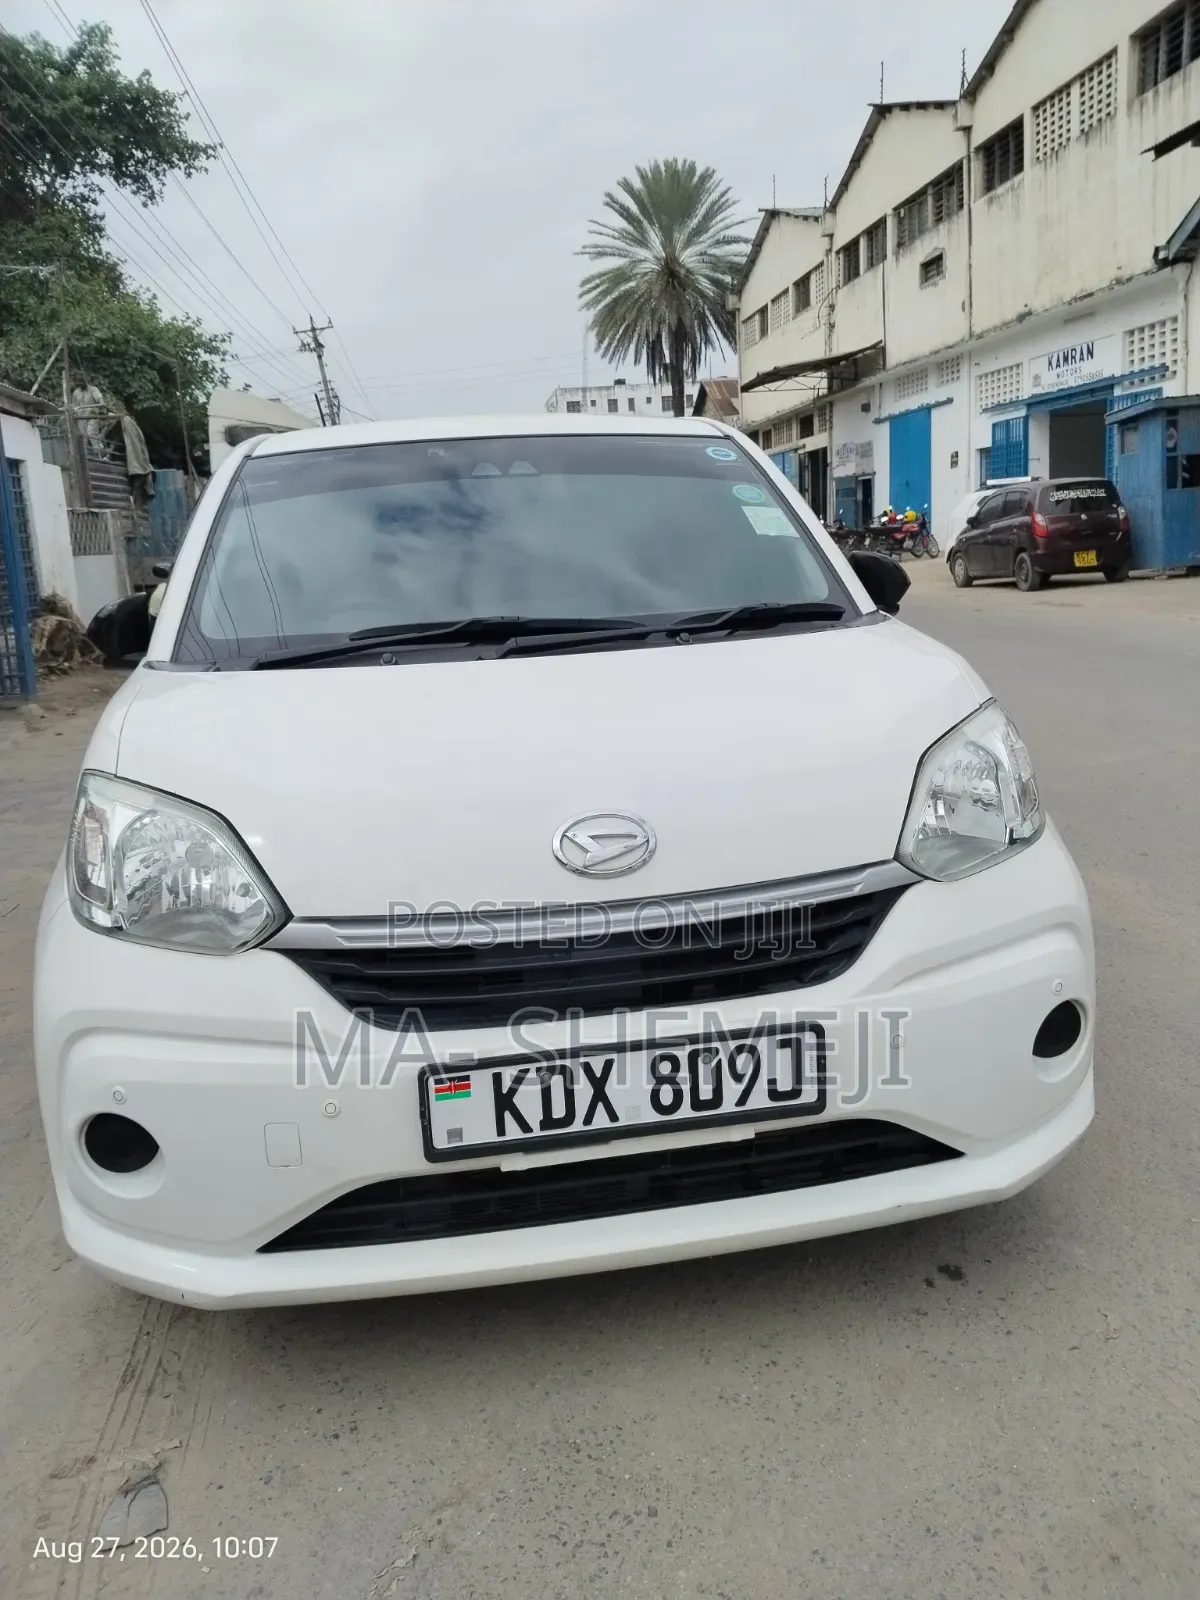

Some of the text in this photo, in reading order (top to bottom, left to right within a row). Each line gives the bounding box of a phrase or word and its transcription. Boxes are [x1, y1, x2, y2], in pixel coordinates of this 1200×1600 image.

[1047, 341, 1094, 372] KAMRAN
[1056, 365, 1082, 379] MOTORS
[492, 1059, 620, 1138] KDX
[649, 1036, 803, 1117] 809J
